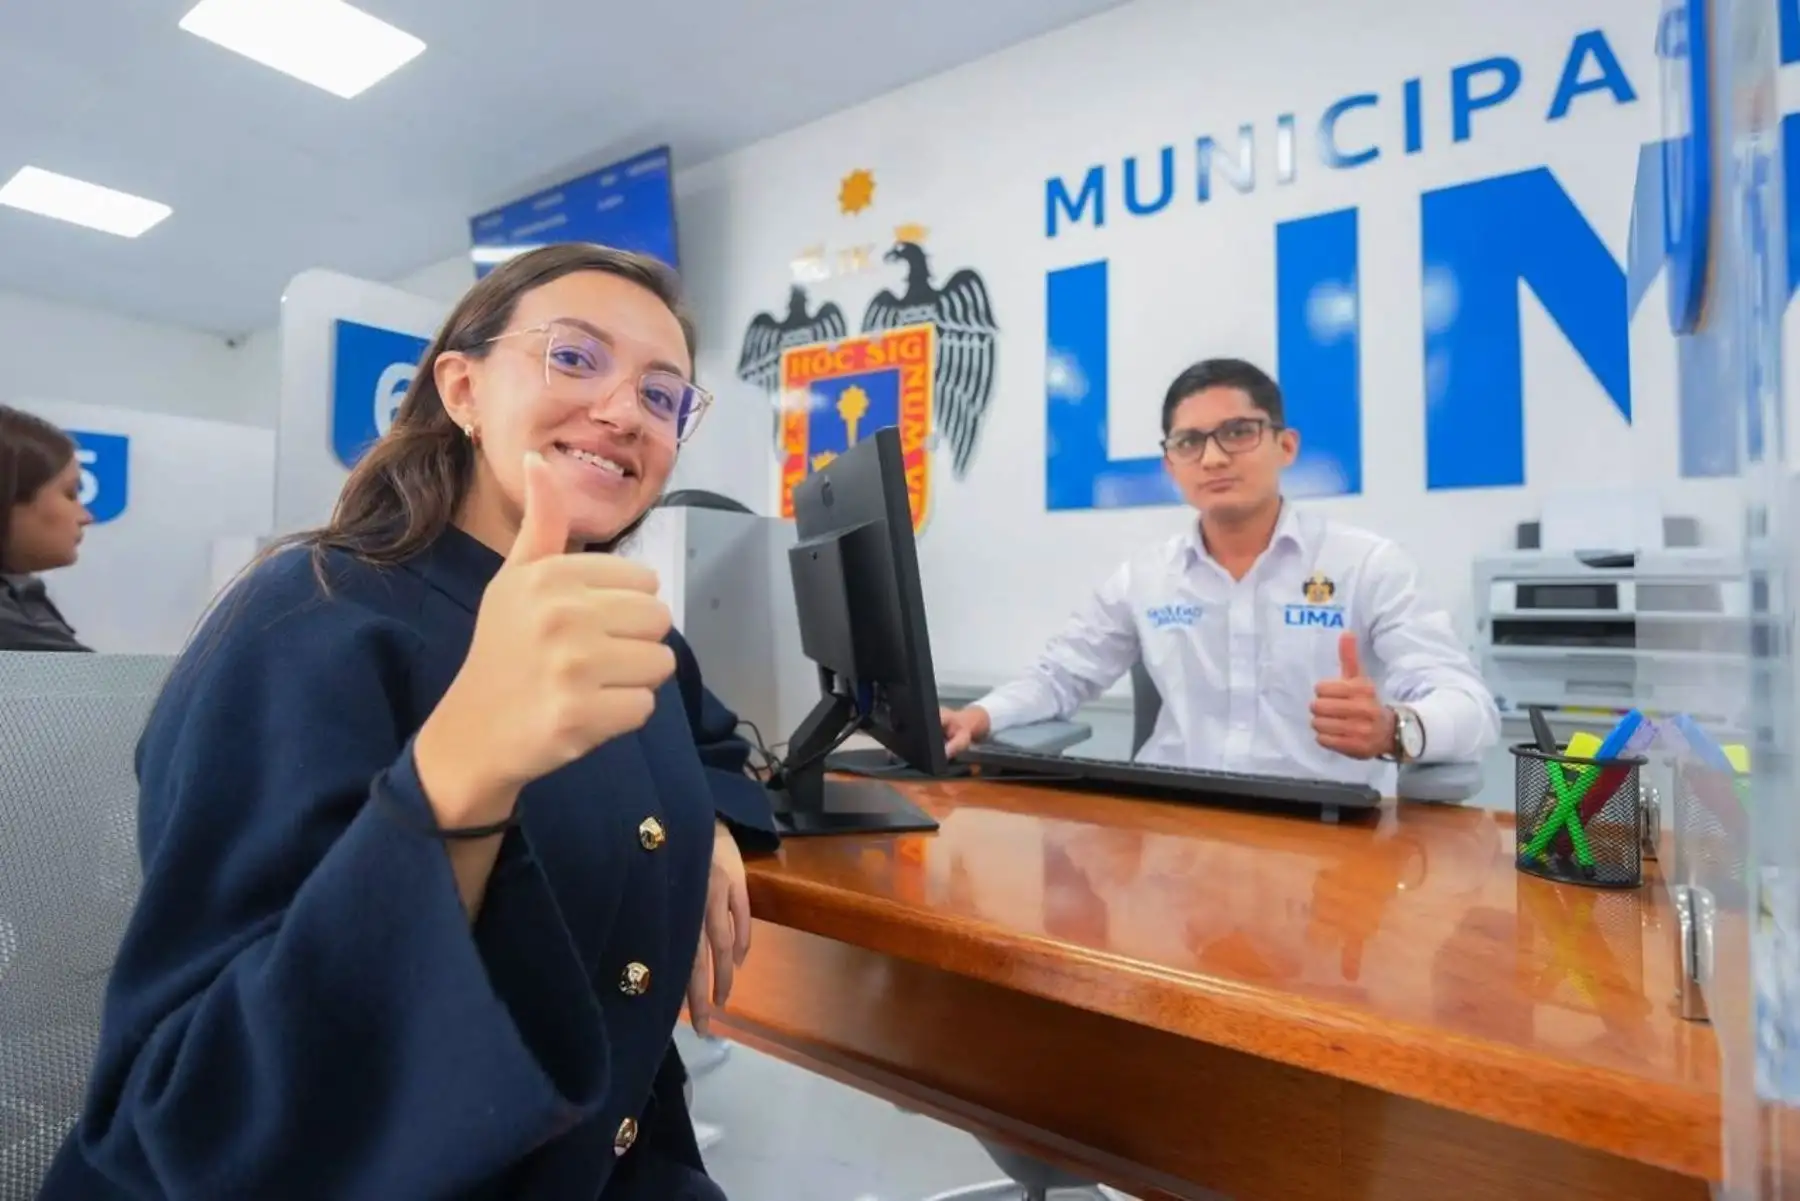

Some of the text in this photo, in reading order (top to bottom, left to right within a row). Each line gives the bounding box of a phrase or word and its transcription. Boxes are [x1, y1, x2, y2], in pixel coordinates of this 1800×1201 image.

[1045, 28, 1638, 238] MUNICIPA
[790, 349, 852, 378] HOC
[1285, 609, 1344, 628] LIMA
